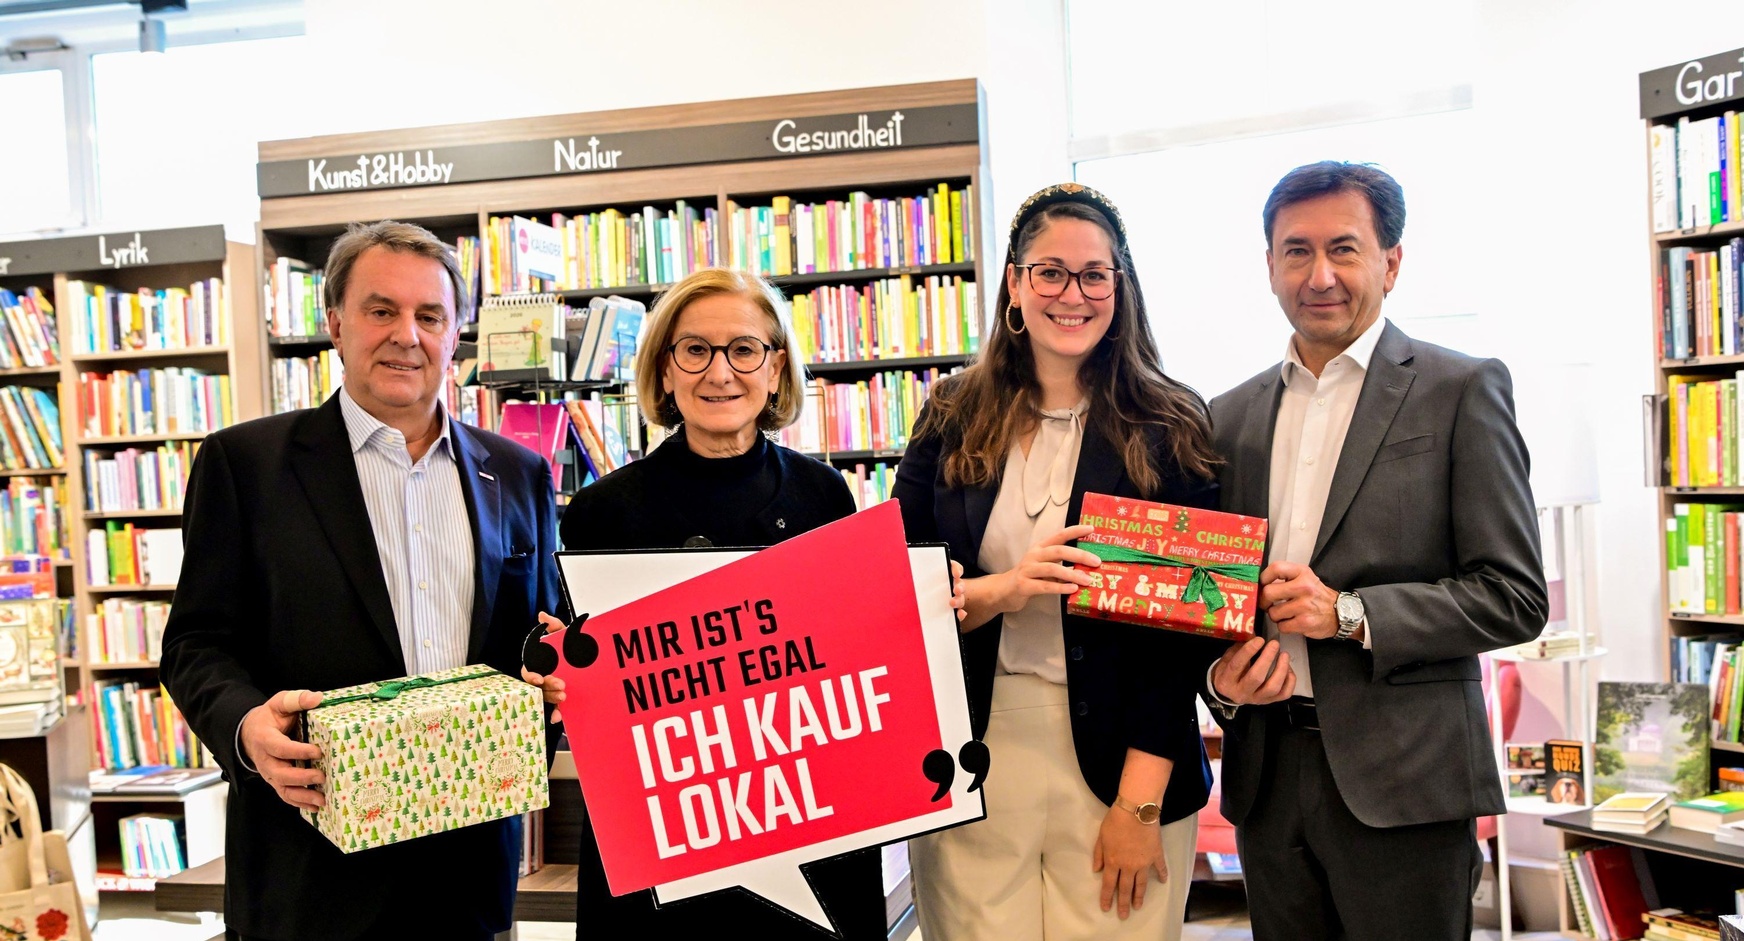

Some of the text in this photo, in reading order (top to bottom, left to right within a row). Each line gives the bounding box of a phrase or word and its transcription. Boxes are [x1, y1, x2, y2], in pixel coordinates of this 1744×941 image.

[772, 111, 905, 153] Gesundheit
[308, 149, 454, 192] Kunst&Hobby
[554, 136, 622, 172] Natur
[99, 232, 149, 269] Lyrik
[1080, 514, 1163, 537] HRISTMAS
[1169, 544, 1262, 566] MERRY CHRISTMAS
[1097, 590, 1175, 622] Merry
[612, 599, 778, 668] MIR IST'S
[622, 636, 826, 714] NICHT EGAL
[630, 665, 891, 789] ICH KAUF
[1553, 758, 1581, 773] QUIZ
[646, 757, 834, 860] LOKAL
